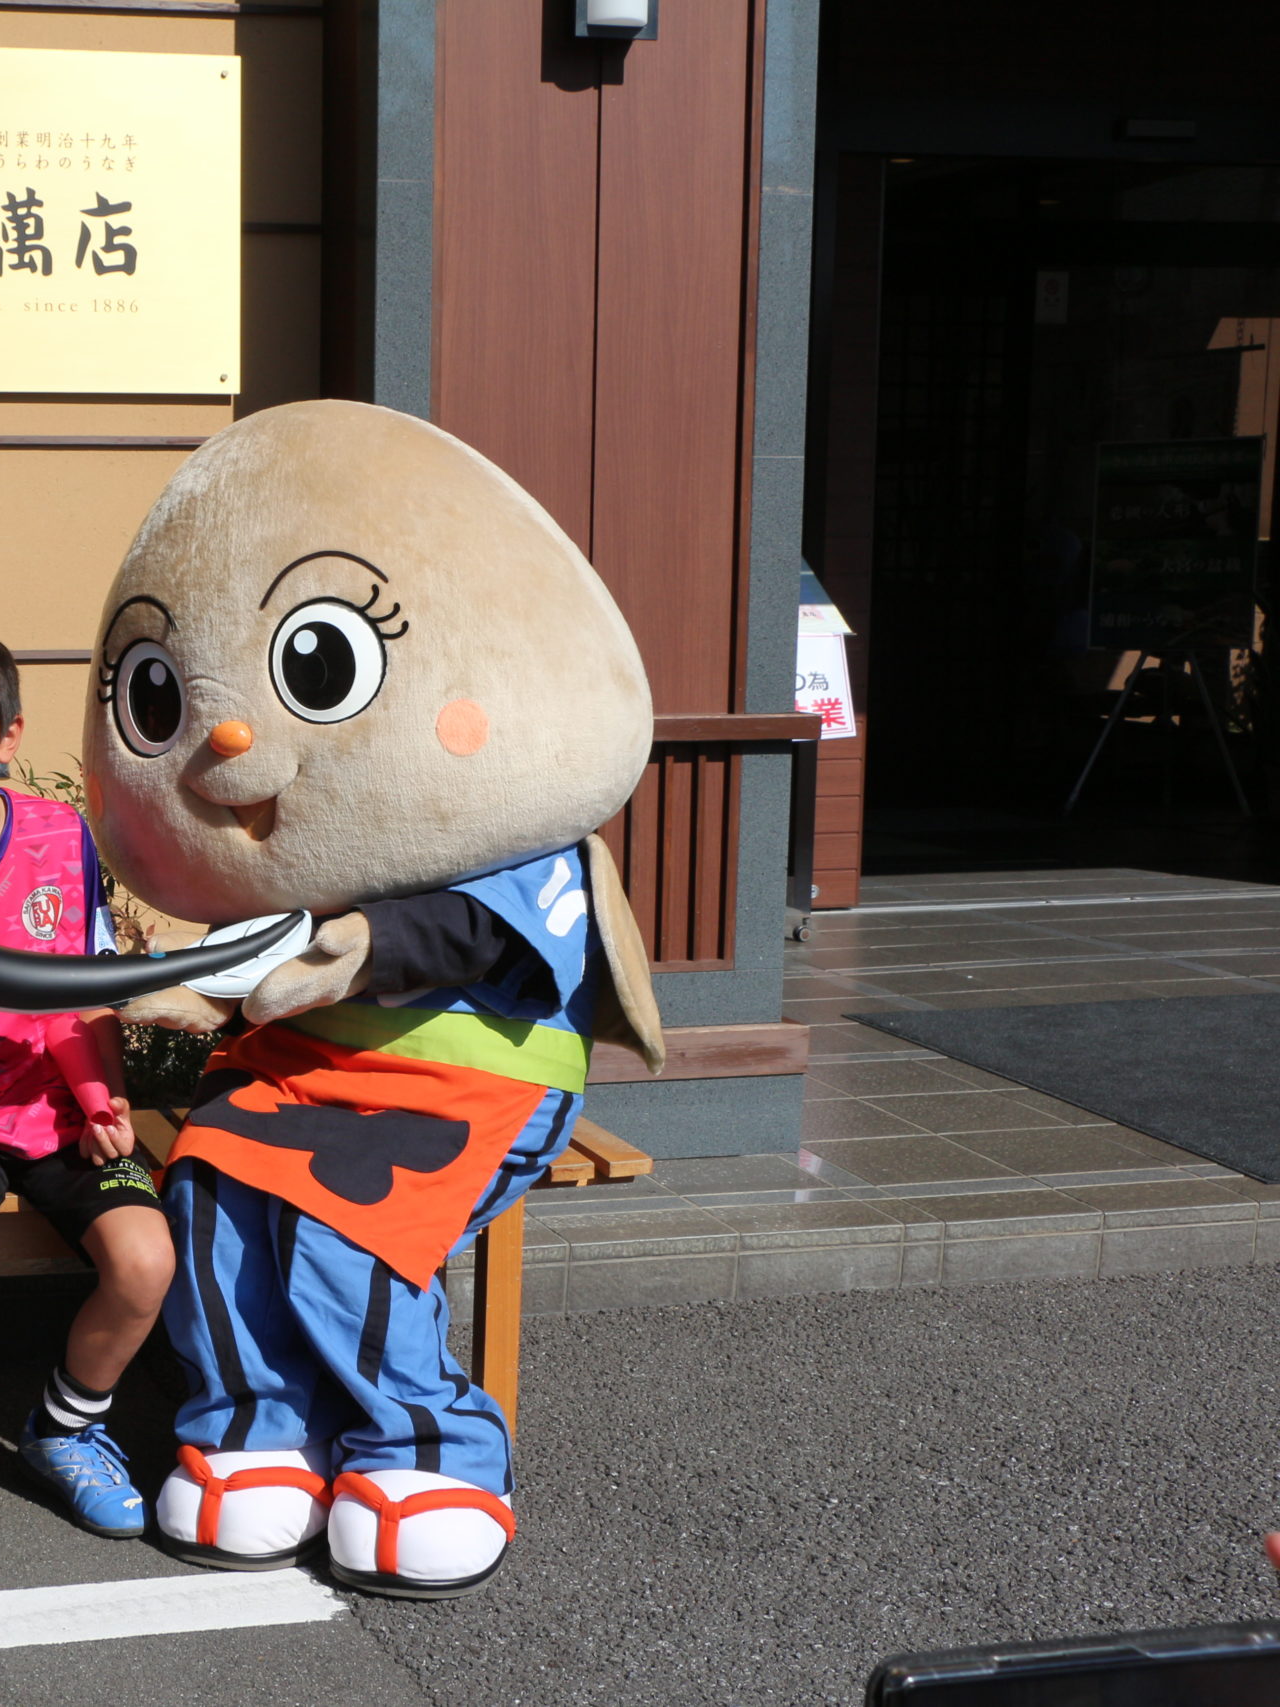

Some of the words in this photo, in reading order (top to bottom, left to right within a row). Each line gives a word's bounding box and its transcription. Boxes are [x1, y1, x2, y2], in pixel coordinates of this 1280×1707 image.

[23, 299, 79, 313] since
[92, 299, 139, 313] 1886
[795, 698, 846, 728] 業
